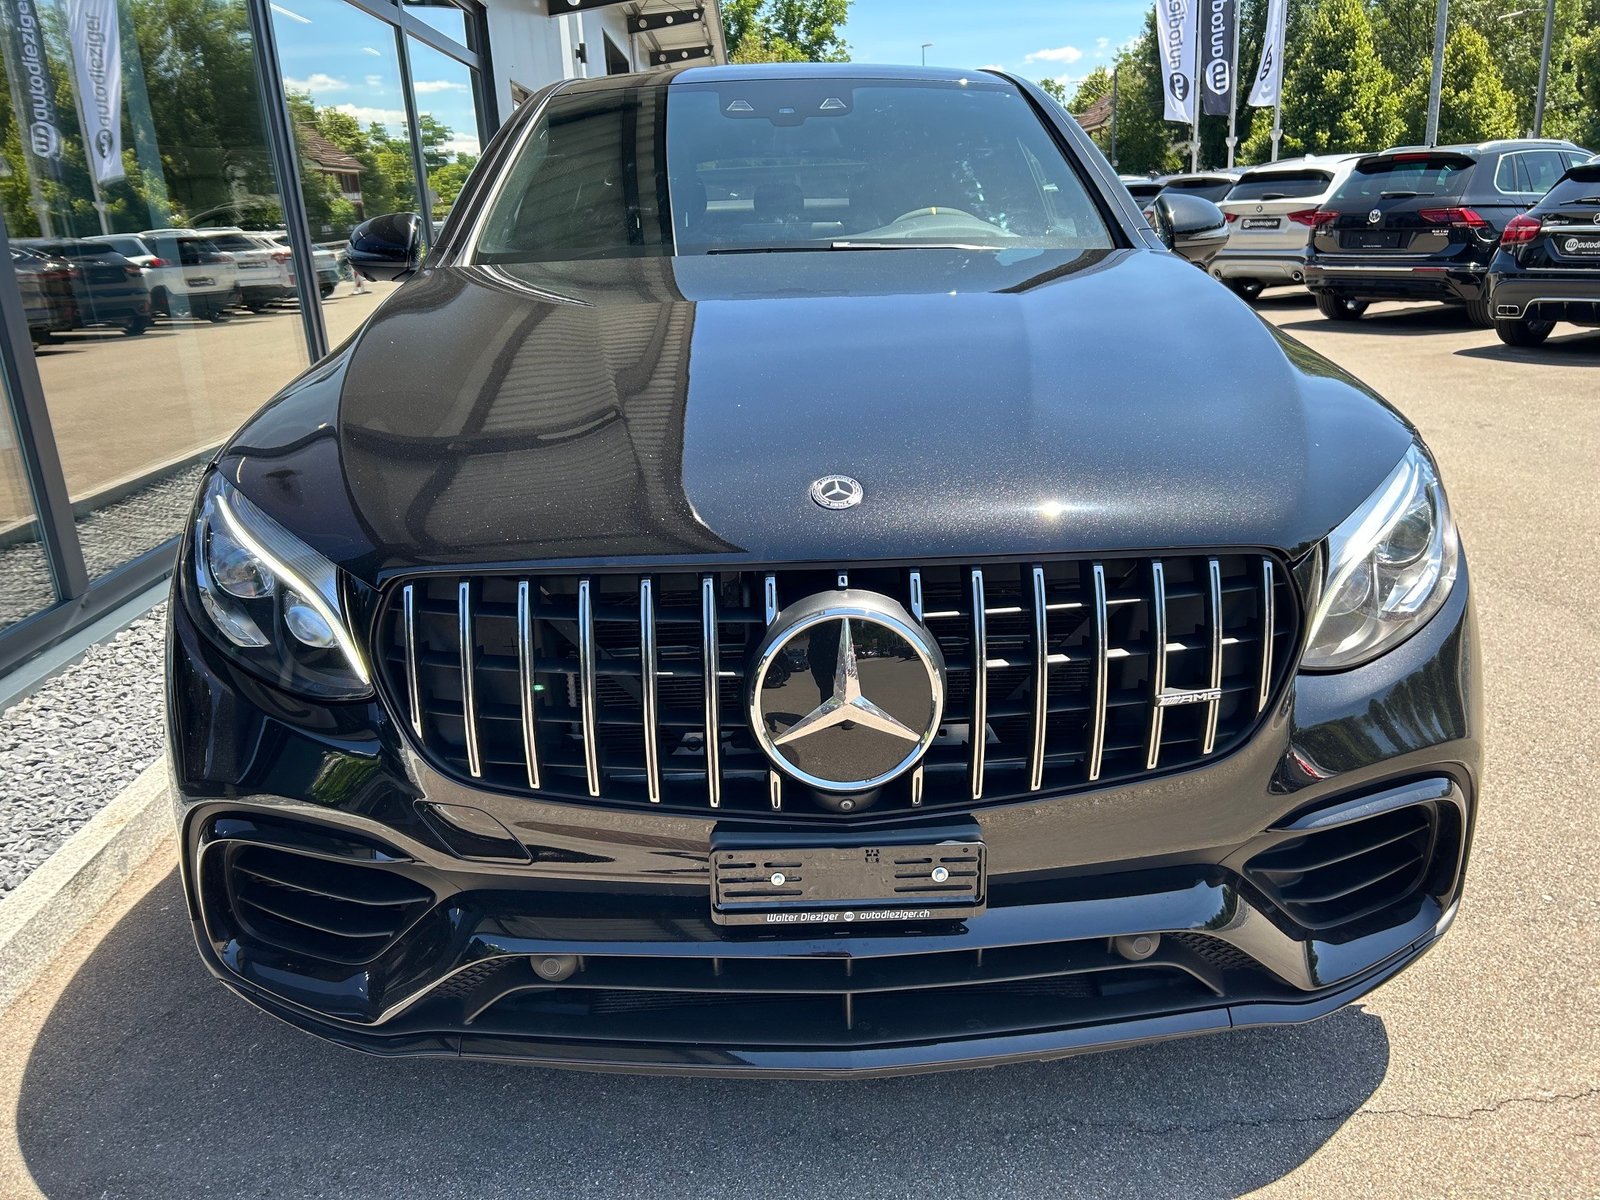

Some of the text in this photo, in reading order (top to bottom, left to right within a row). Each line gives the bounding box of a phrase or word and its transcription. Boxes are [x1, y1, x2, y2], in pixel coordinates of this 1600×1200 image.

[16, 0, 49, 121] autodiezige
[84, 13, 110, 127] autodieziger
[1179, 692, 1220, 703] AMG
[766, 909, 930, 922] Walter Dieziger autodieziger.ch
